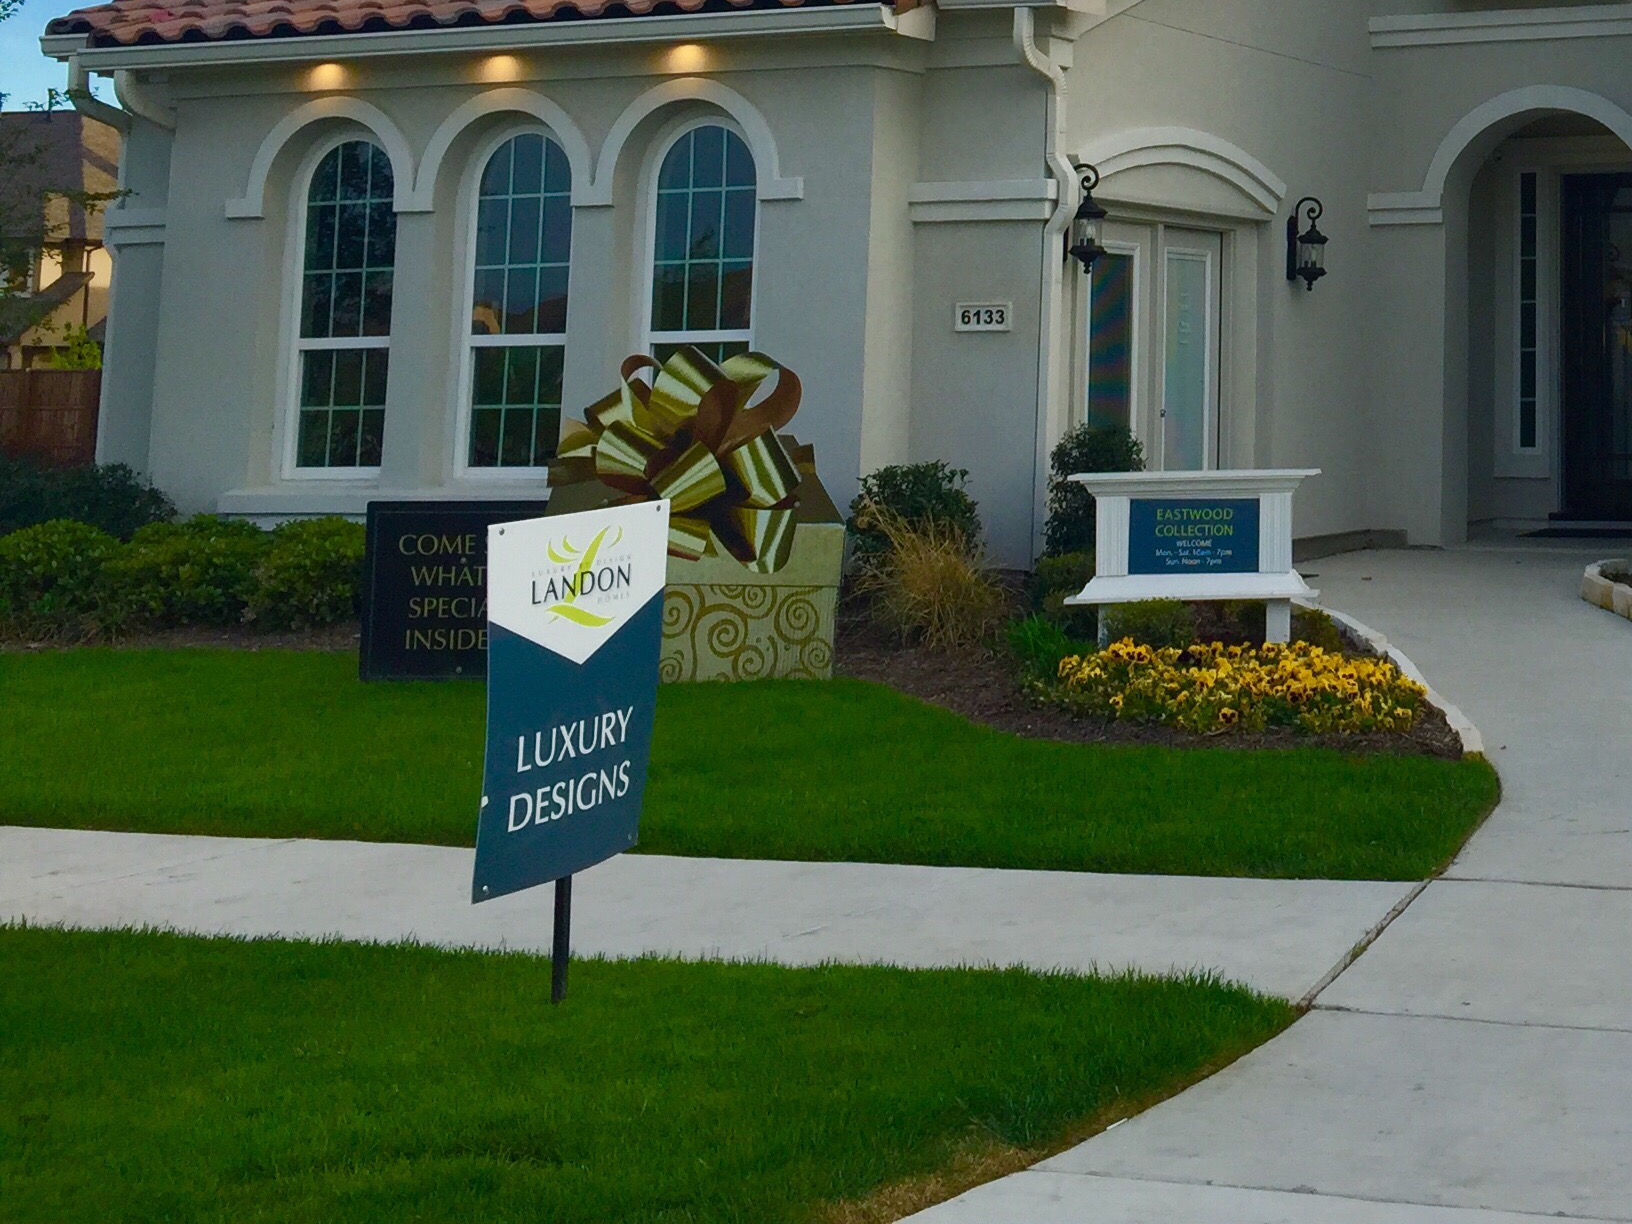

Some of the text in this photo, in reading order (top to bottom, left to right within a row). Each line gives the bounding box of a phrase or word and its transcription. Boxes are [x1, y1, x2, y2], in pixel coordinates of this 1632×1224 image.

[961, 309, 1005, 325] 6133
[1156, 507, 1234, 521] EASTWOOD
[1155, 524, 1234, 537] COLLECTION
[399, 534, 476, 555] COME
[1176, 539, 1212, 547] WELCOME
[411, 565, 487, 587] WHAT
[531, 563, 631, 605] LANDON
[408, 597, 487, 618] SPECIA
[405, 629, 487, 650] INSIDE
[517, 706, 633, 773] LUXURY
[507, 760, 631, 834] DESIGNS
